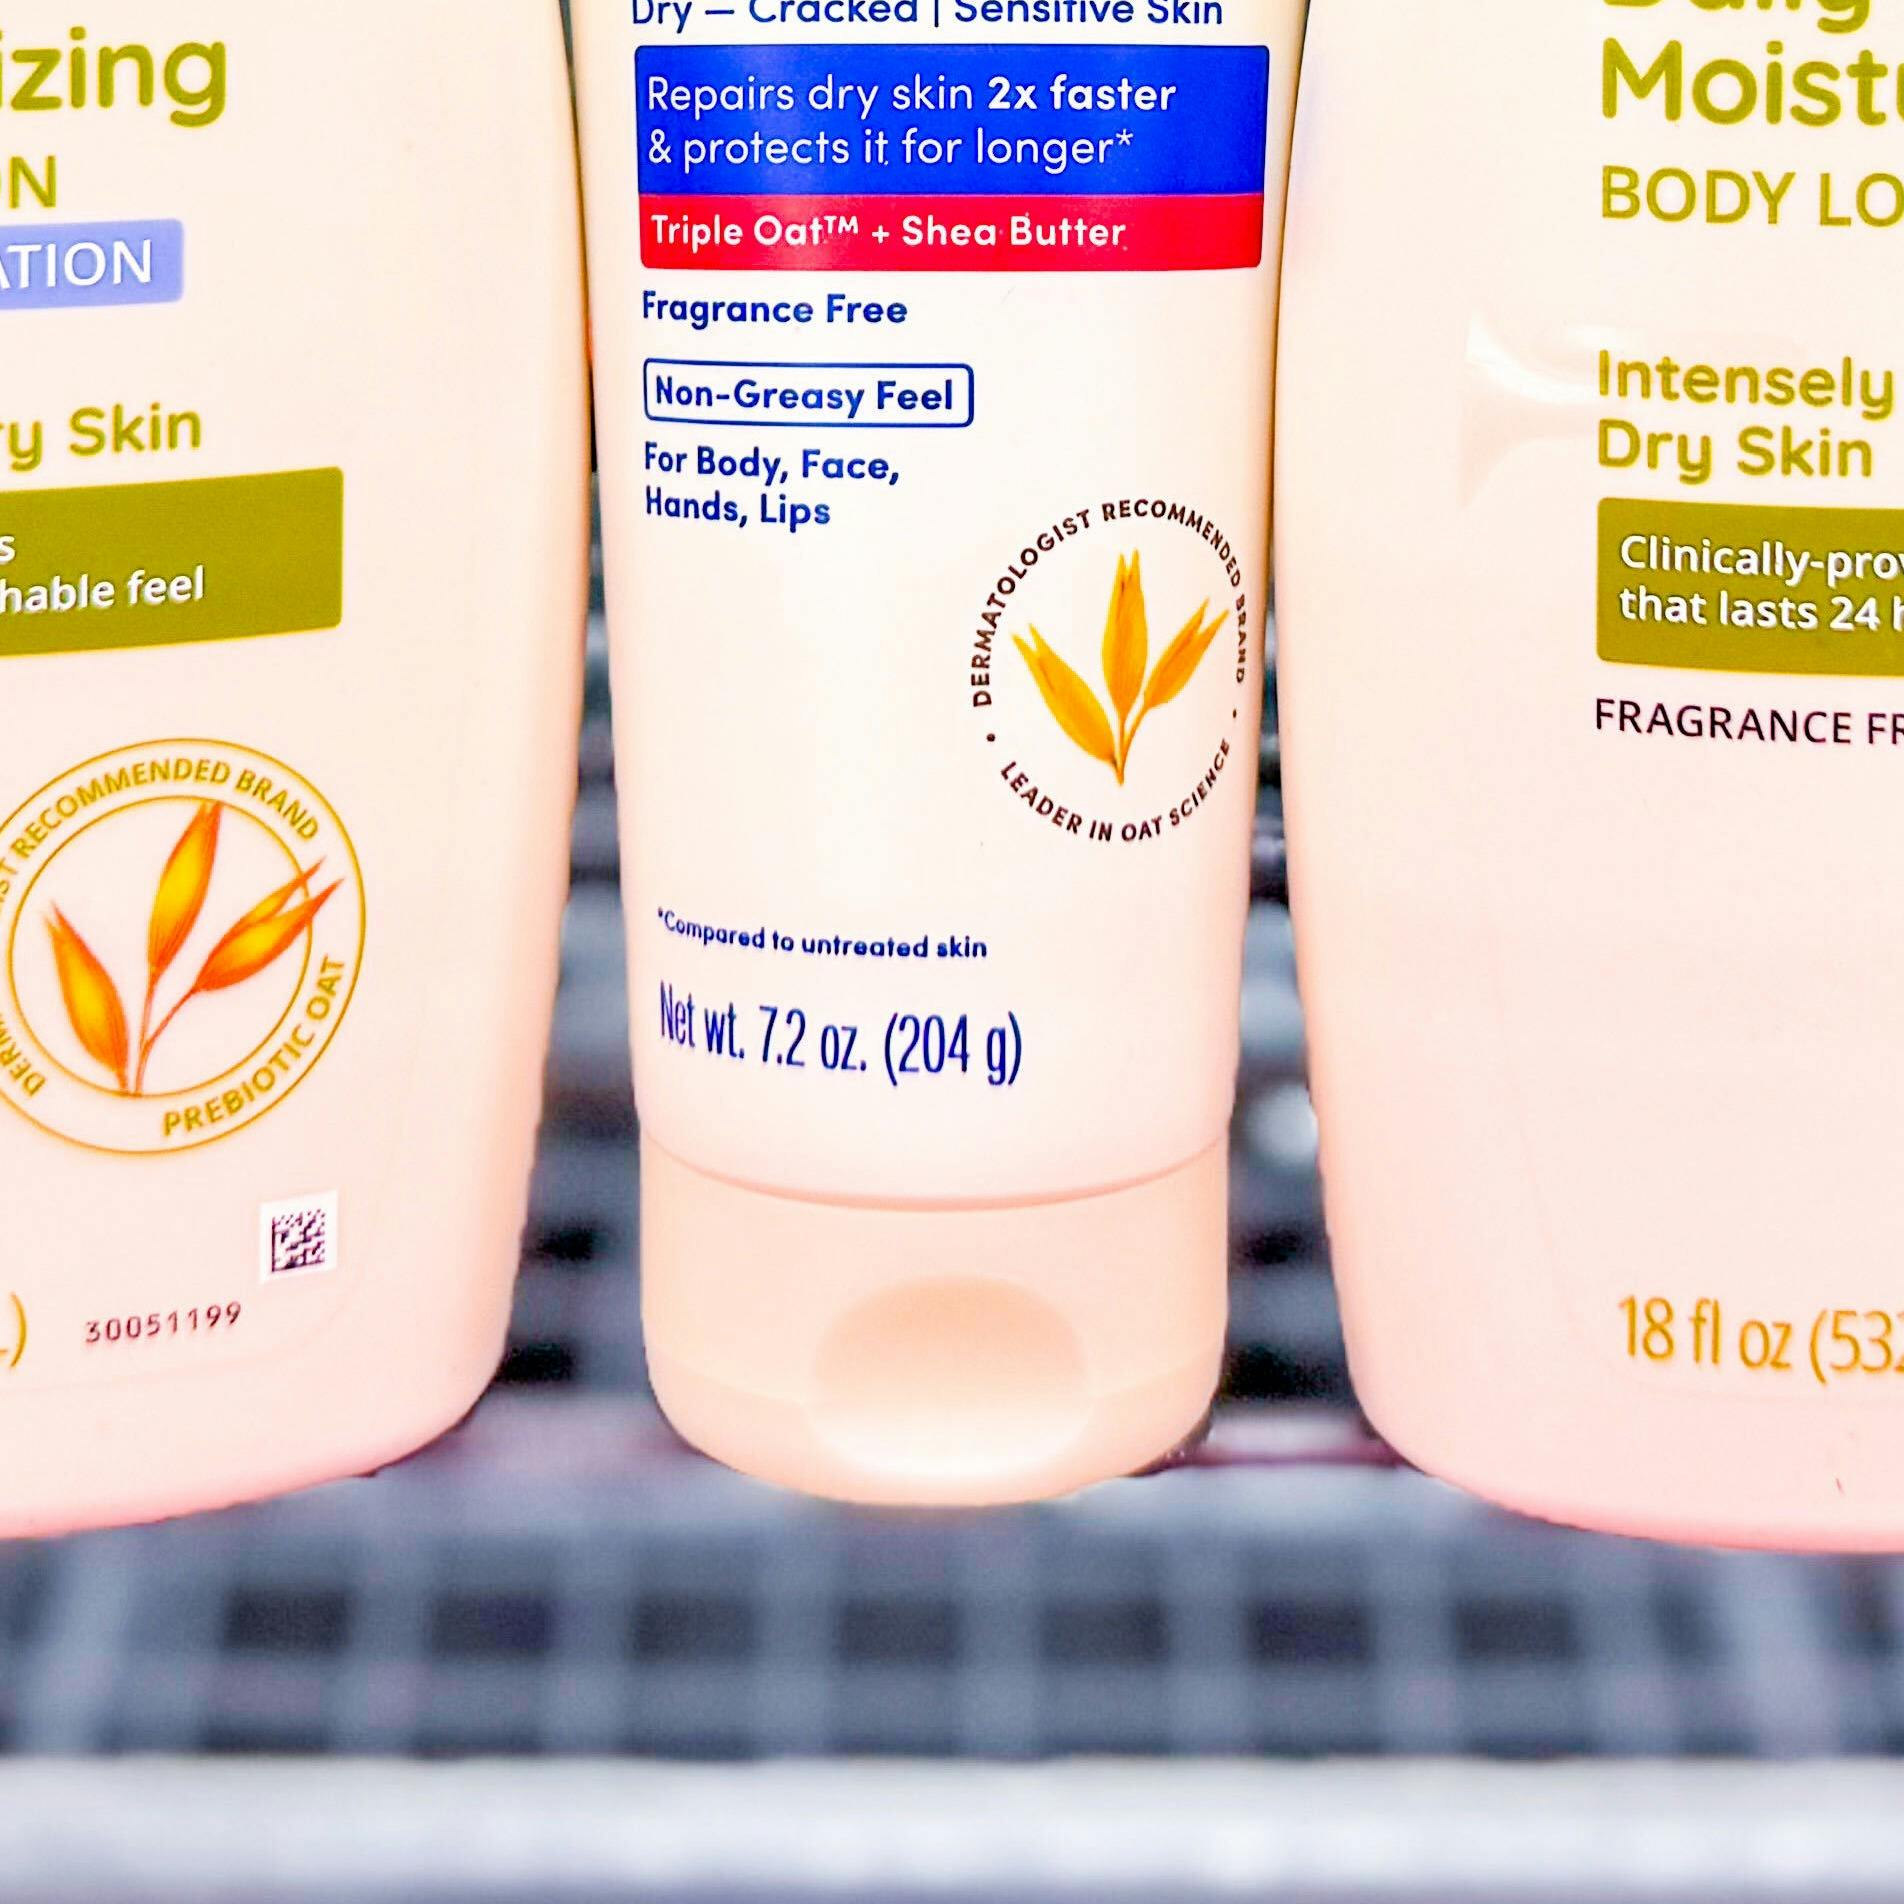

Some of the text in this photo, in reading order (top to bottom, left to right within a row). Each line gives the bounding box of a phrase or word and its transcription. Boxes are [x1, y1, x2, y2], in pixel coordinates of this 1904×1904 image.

[649, 73, 1176, 120] Repairs dry skin 2x faster
[649, 129, 671, 163] &
[684, 132, 849, 173] protects
[865, 129, 888, 165] it
[902, 128, 962, 164] for
[1602, 165, 1796, 224] BODY
[651, 214, 743, 253] Triple
[872, 225, 889, 243] +
[903, 215, 996, 245] Shea
[1011, 213, 1126, 246] Butter
[643, 290, 907, 330] Fragrance Free
[656, 375, 952, 418] Non-Greasy Feel
[1599, 350, 1894, 422] Intensely
[69, 402, 201, 457] Skin
[1598, 418, 1872, 485] Dry Skin
[645, 441, 898, 486] For Body, Face,
[646, 485, 830, 533] Hands, Lips
[127, 565, 204, 605] feel
[971, 498, 1246, 707] DERMATOLOGIST RECOMMENDED BRAND
[1620, 585, 1706, 624] that
[1720, 591, 1818, 629] lasts
[1830, 597, 1880, 630] 24
[1597, 698, 1851, 743] FRAGRANCE
[10, 758, 230, 862] RECOMMENDED
[235, 769, 319, 843] BRAND
[1001, 738, 1230, 843] LEADER IN OAT SCIENCE
[773, 932, 794, 951] to
[802, 936, 928, 957] untreated
[937, 936, 987, 957] skin
[162, 953, 345, 1136] PREBIOTIC OAT
[661, 982, 1021, 1086] Net wt. 7.2 oz. (204 g)
[86, 1302, 241, 1343] 30051199
[1621, 1296, 1674, 1361] 18
[1691, 1299, 1721, 1365] fl
[1739, 1320, 1792, 1371] oz
